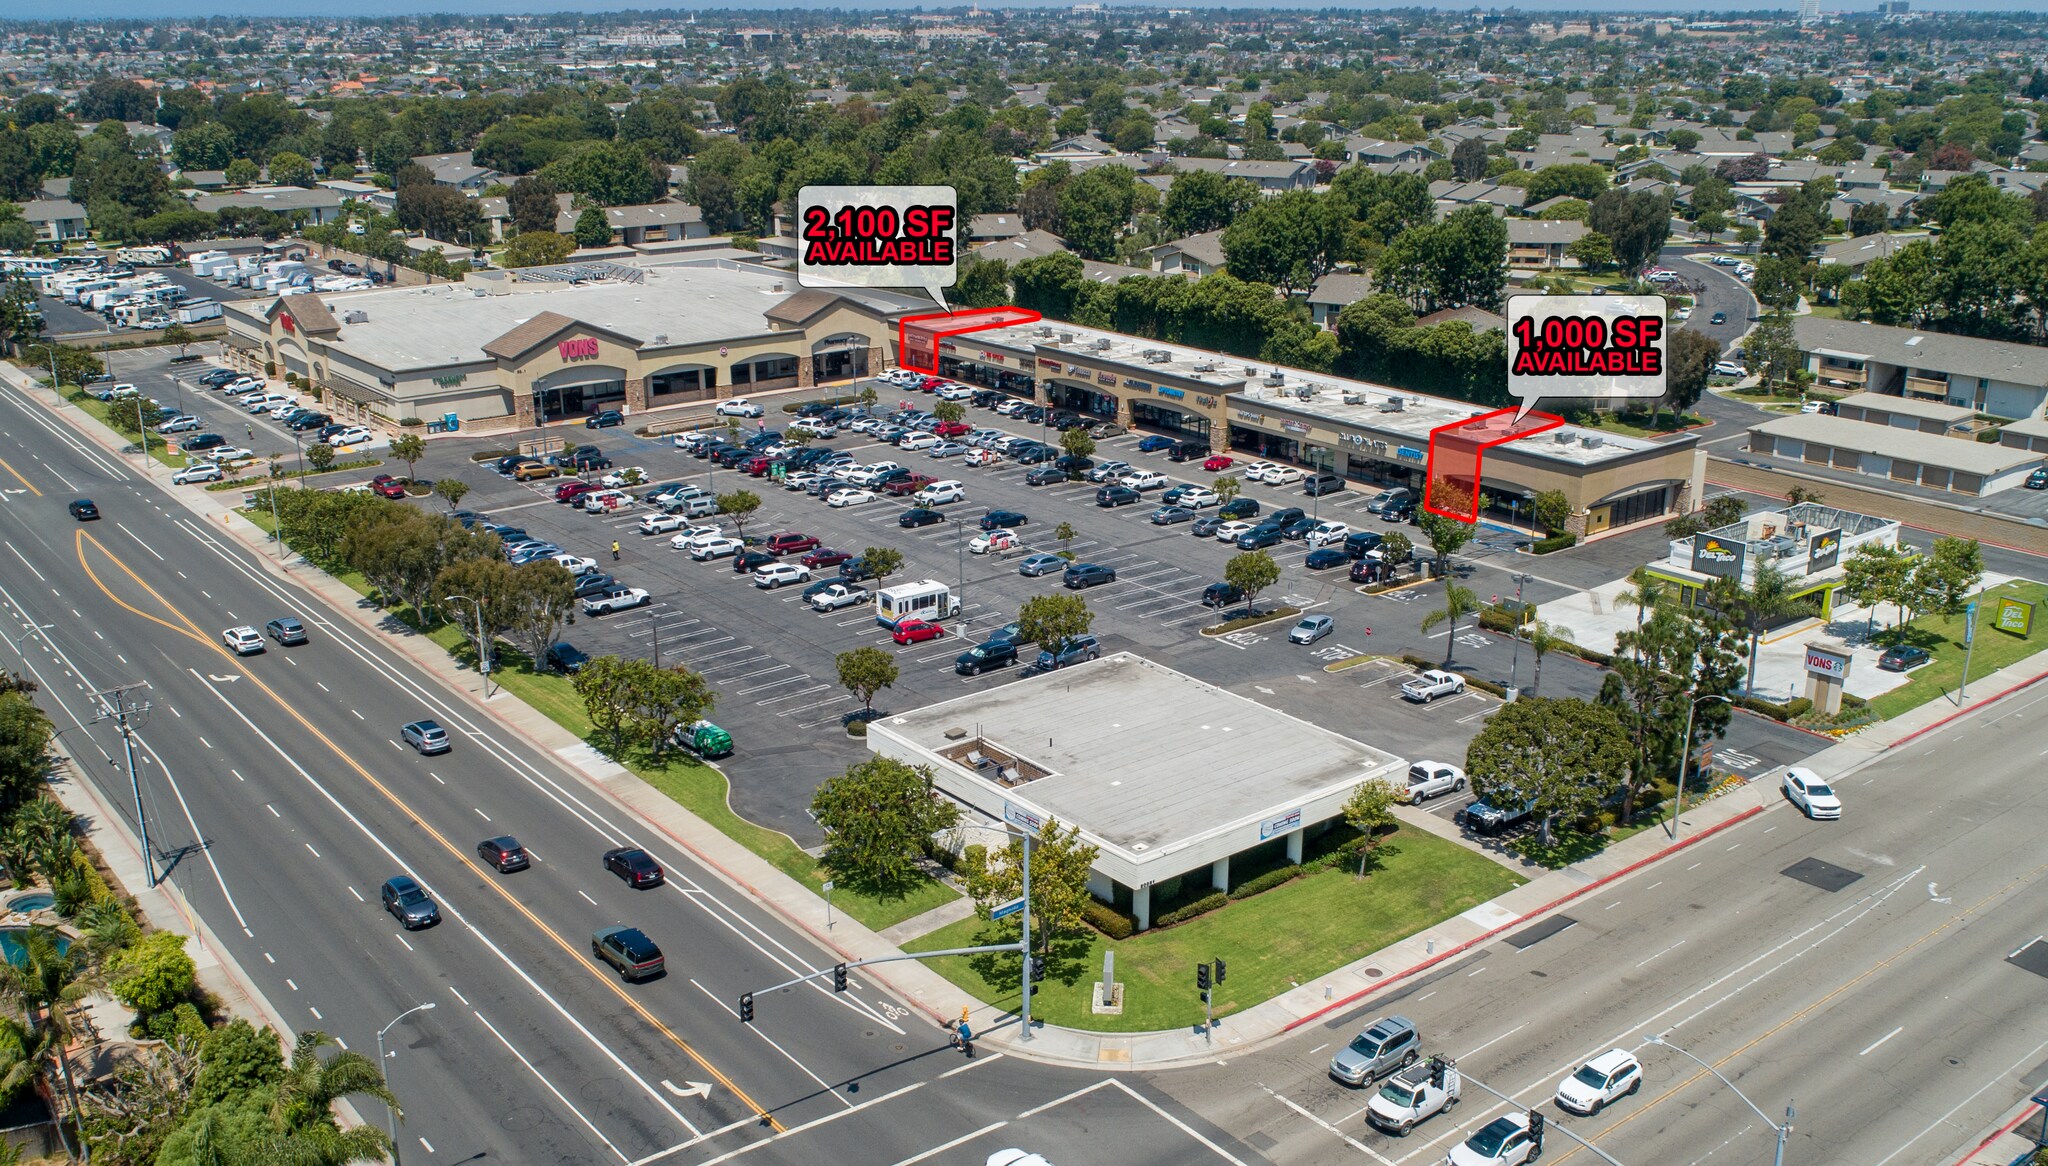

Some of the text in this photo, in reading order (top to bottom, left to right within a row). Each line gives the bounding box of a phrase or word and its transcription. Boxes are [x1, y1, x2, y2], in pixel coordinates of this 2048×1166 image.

[558, 337, 599, 360] VONS
[1397, 447, 1424, 460] DENTIST
[1807, 654, 1833, 671] VONS
